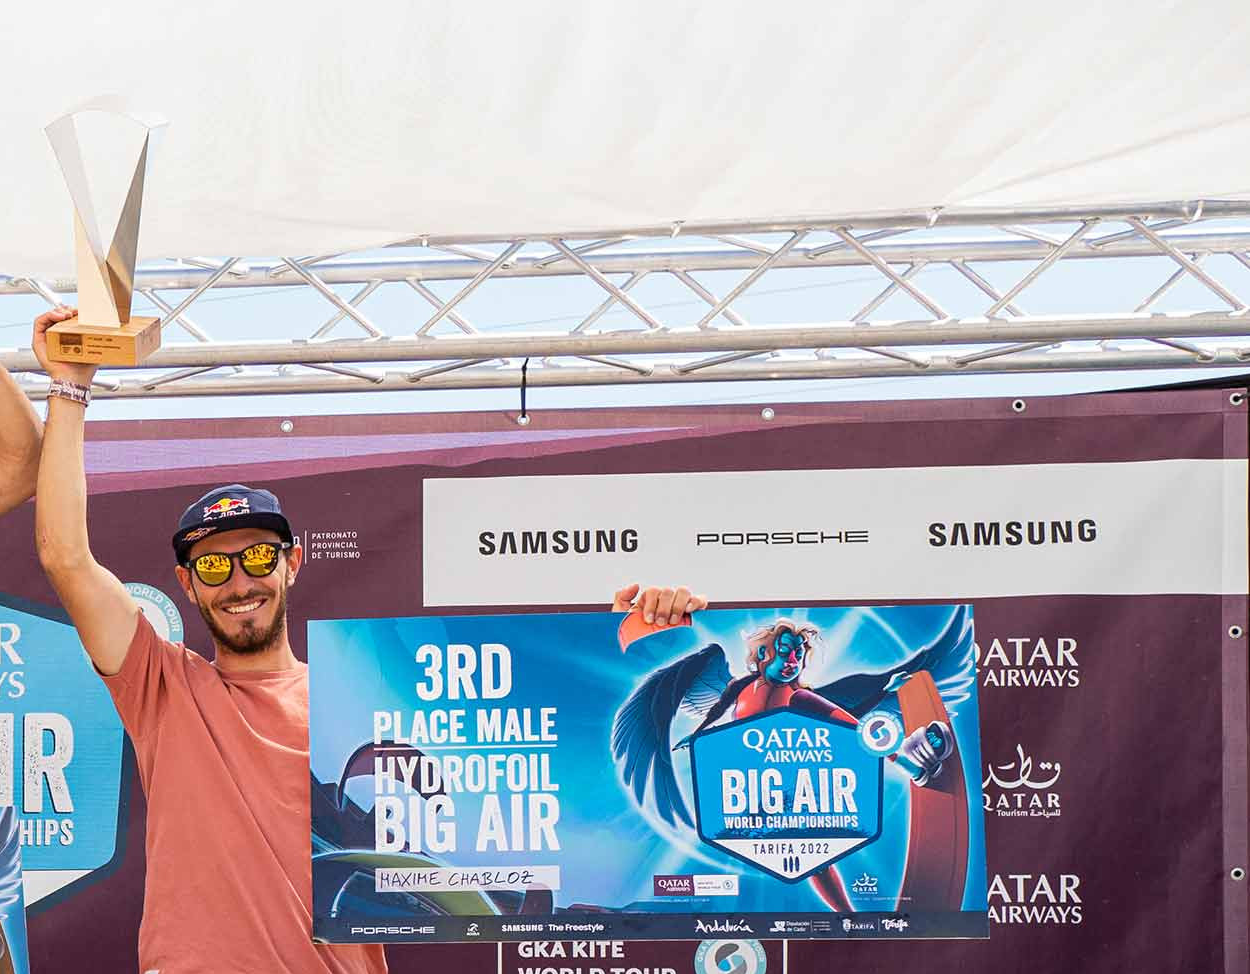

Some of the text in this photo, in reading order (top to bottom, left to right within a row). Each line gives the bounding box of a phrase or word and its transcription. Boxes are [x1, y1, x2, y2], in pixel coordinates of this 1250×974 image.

[312, 532, 358, 540] PATRONATO
[479, 519, 1096, 555] SAMSUNG PORSCHE SAMSUNG
[416, 643, 512, 701] 3RD
[984, 669, 1079, 687] AIRWAYS
[374, 708, 557, 744] PLACE MALE
[743, 728, 831, 752] QATAR
[764, 750, 833, 763] AIRWAYS
[374, 754, 559, 794] HYDROFOIL
[722, 768, 858, 814] BIG AIR
[983, 793, 1060, 811] QATAR
[375, 794, 560, 853] BIG AIR
[724, 815, 858, 829] WORLD CHAMPIONSHIPS
[753, 843, 829, 855] TARIFA 2022
[380, 871, 533, 888] MAXIME CHABLOZ
[658, 880, 690, 888] QATAR
[987, 875, 1082, 903] ATAR
[988, 906, 1082, 924] AIRWAYS
[351, 923, 604, 935] PORSCHE SAMSUNG The Freestyle
[694, 919, 754, 933] Andalucía
[518, 941, 624, 958] GKA KITE
